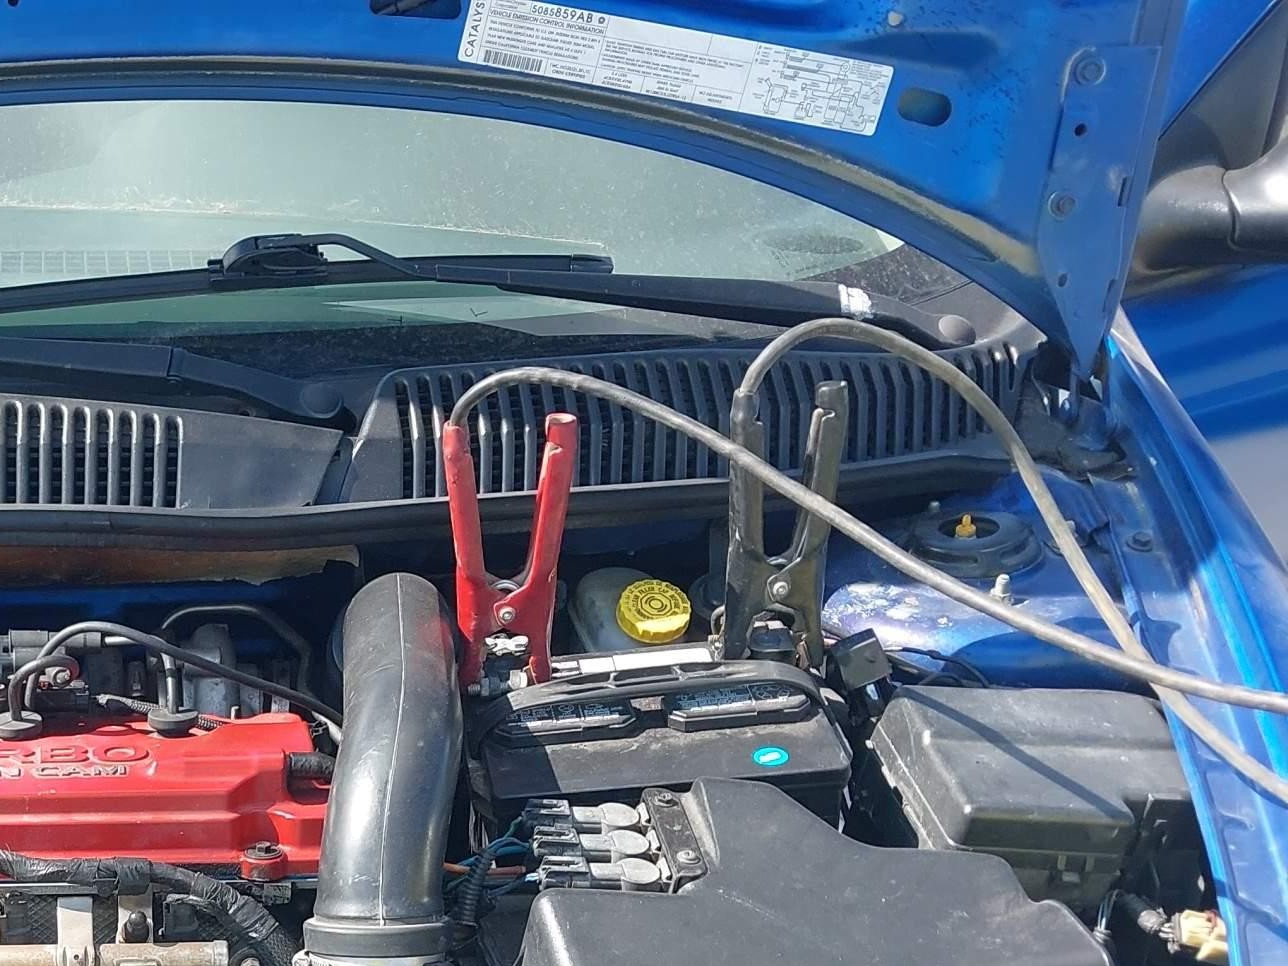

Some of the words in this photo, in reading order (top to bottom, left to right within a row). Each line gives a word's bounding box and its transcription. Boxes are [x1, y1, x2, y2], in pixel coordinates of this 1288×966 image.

[490, 9, 511, 18] VEHICLE
[512, 13, 539, 23] EMISSION
[539, 17, 563, 27] CONTROL
[565, 22, 605, 34] INFORMATION
[531, 4, 594, 24] 5085859AB
[638, 586, 656, 598] FILLER
[35, 764, 129, 777] CAM
